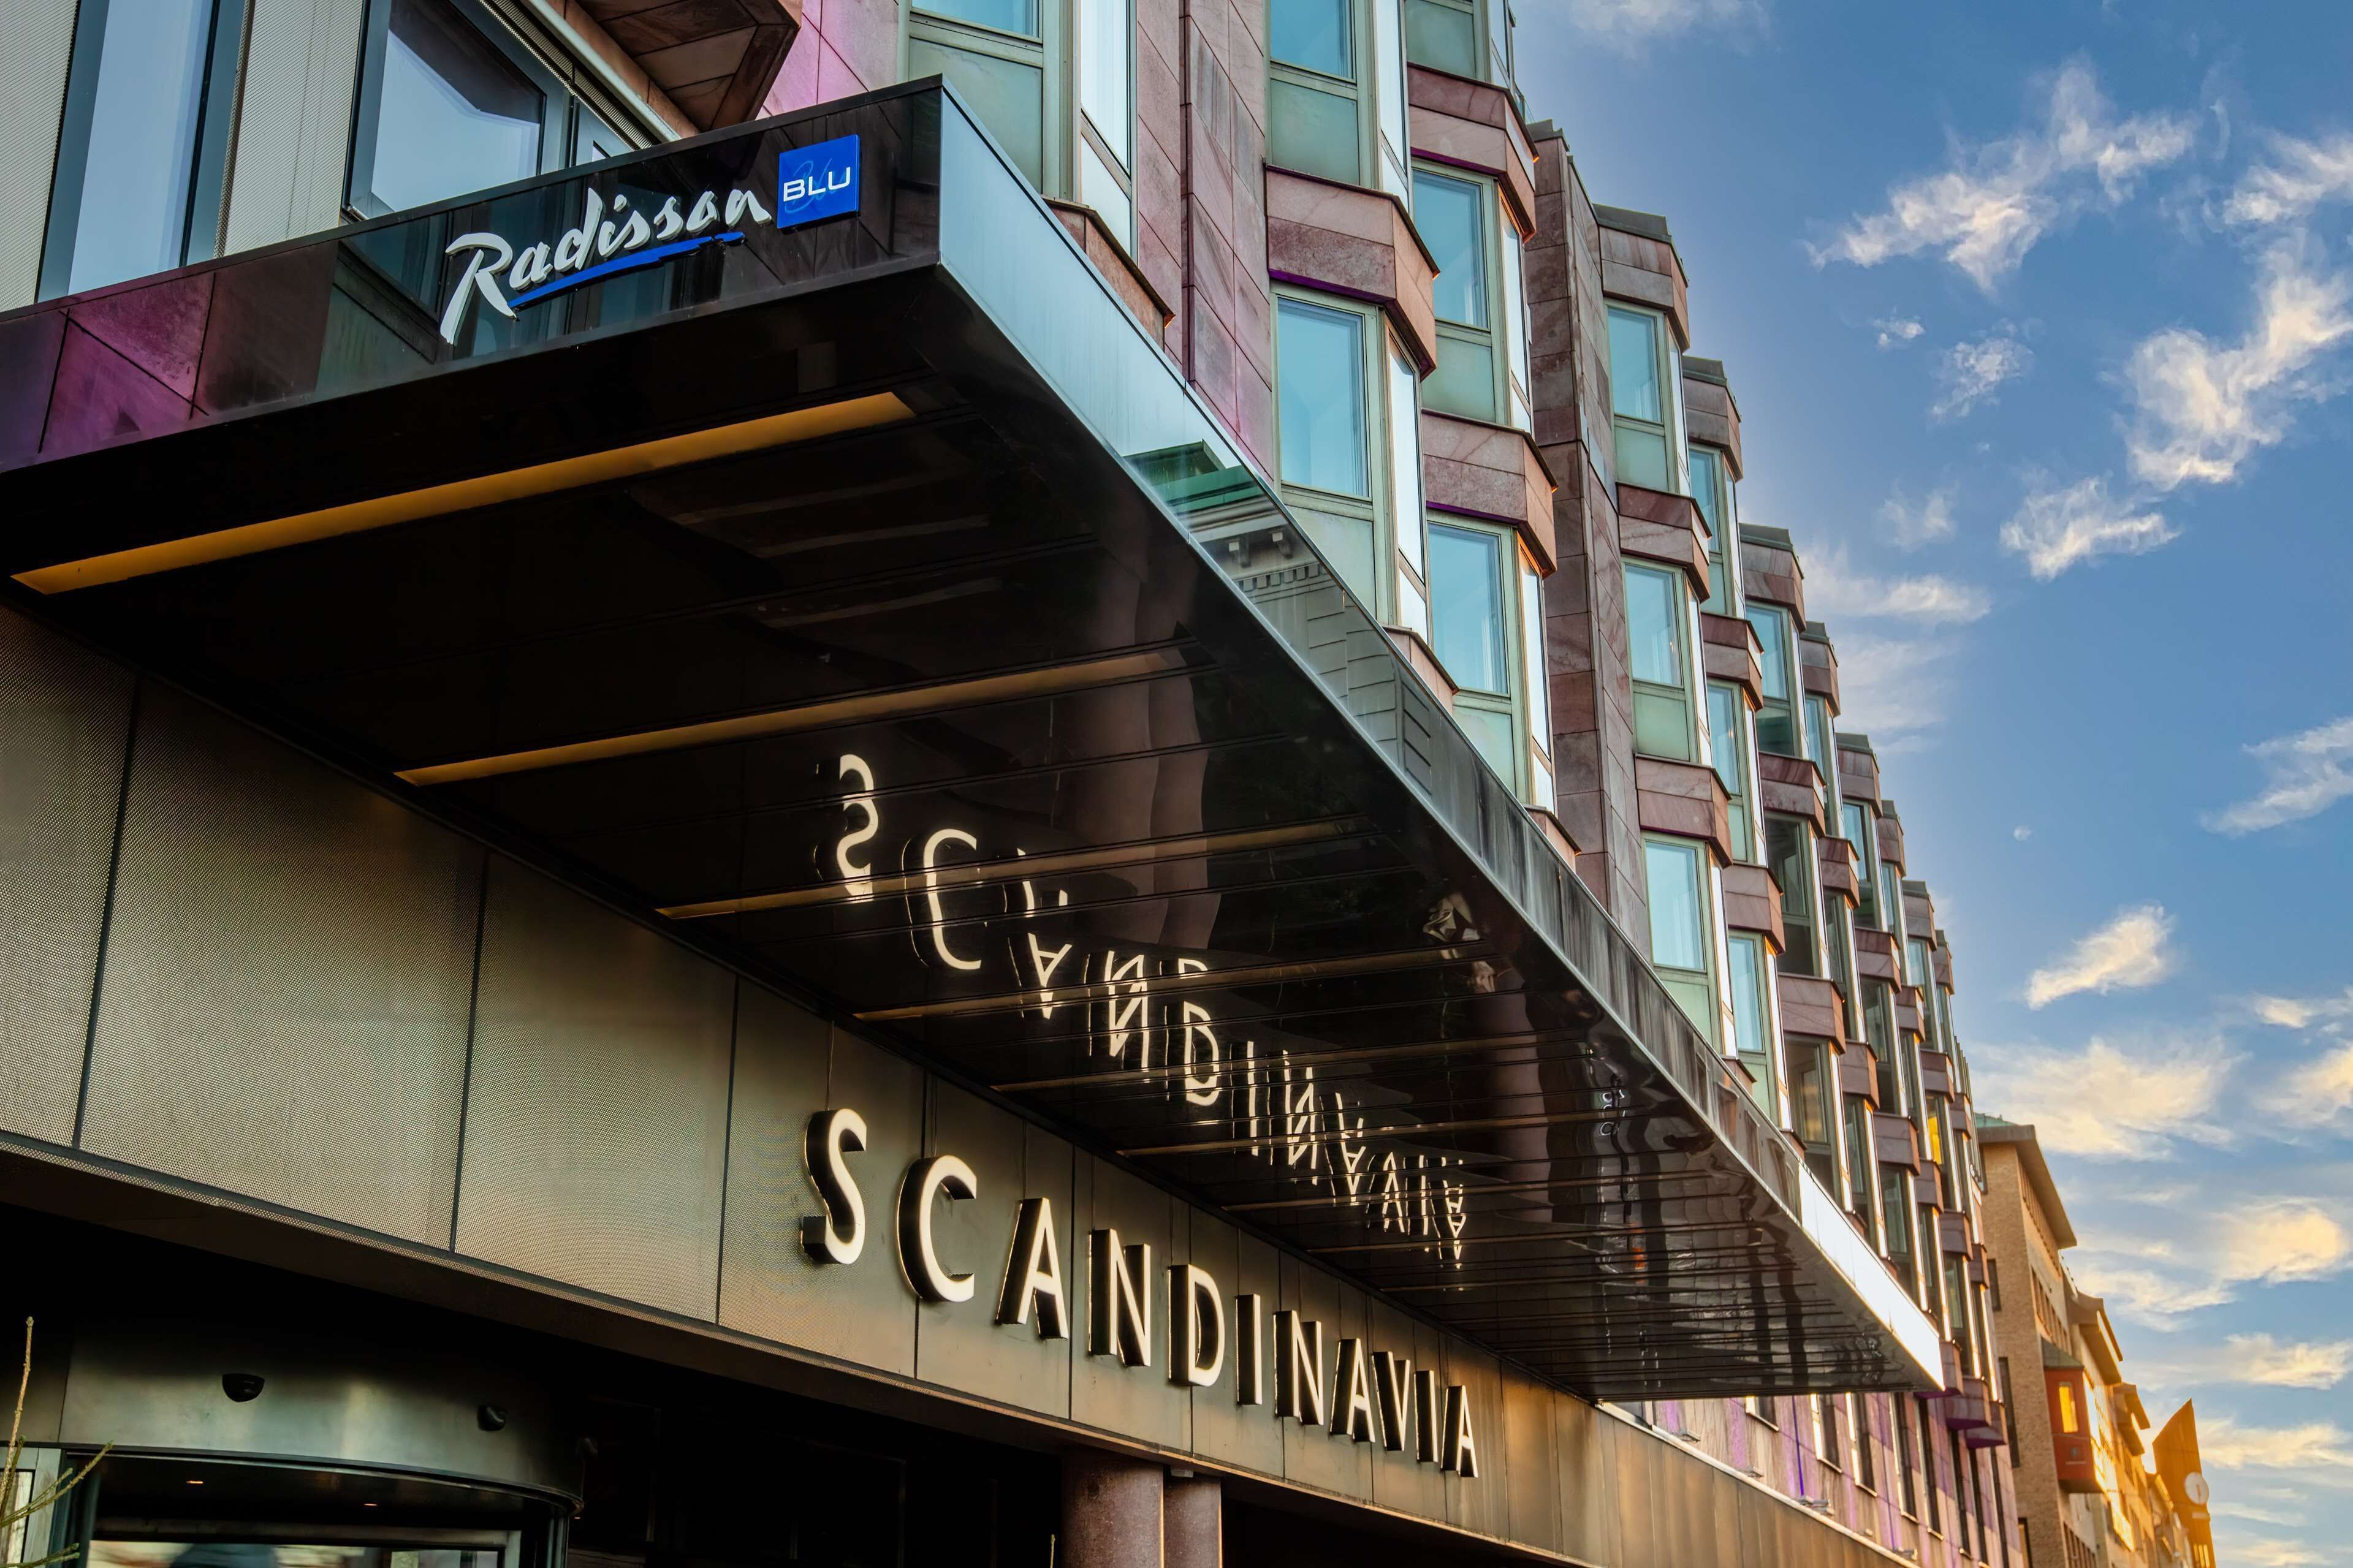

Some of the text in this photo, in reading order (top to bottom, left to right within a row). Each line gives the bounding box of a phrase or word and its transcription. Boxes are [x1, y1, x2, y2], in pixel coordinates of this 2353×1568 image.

[439, 166, 851, 345] Radisson BLU
[801, 1108, 1479, 1479] SCANDINAVIA
